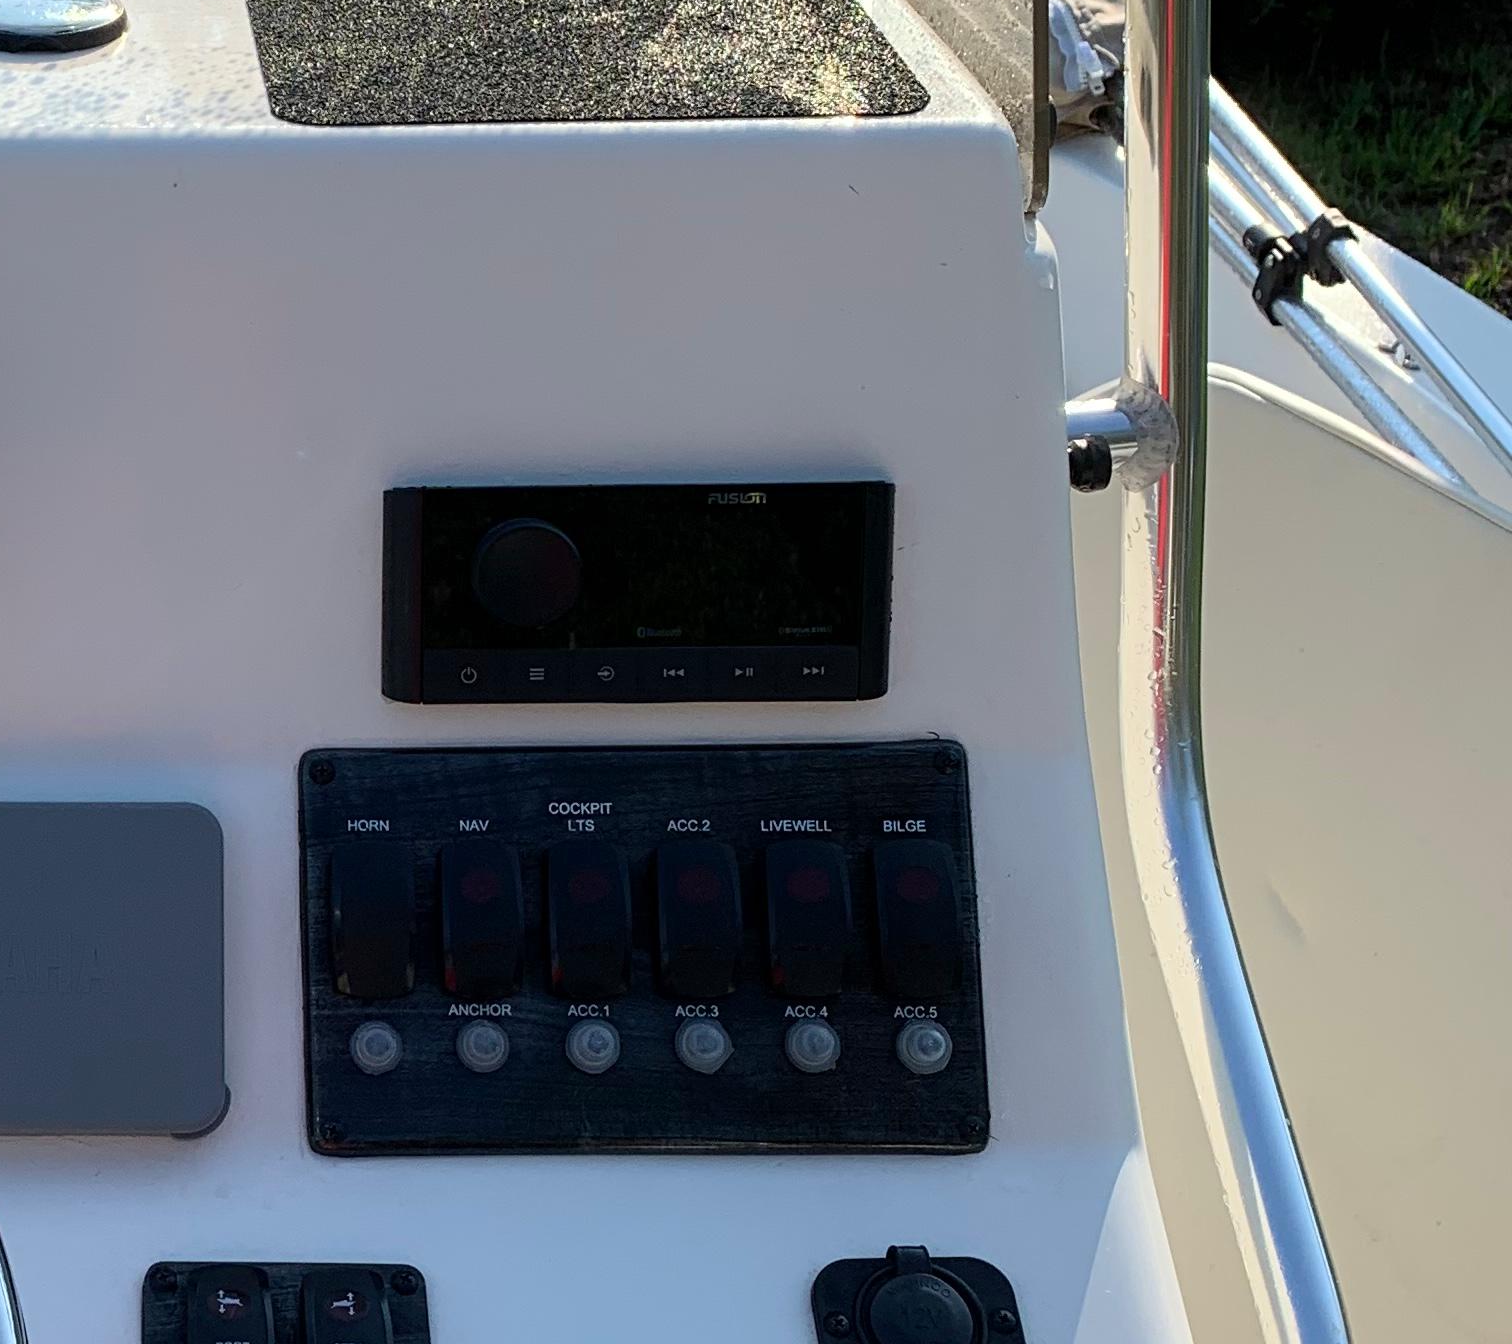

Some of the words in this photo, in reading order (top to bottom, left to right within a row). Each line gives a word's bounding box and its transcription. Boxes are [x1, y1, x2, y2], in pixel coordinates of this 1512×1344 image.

[548, 802, 613, 815] COCKPIT
[347, 819, 390, 832] HORN
[459, 819, 490, 832] NAV
[567, 819, 595, 832] LTS
[667, 818, 711, 832] ACC.2
[760, 819, 832, 832] LIVEWELL
[883, 819, 927, 833] BILGE
[448, 1003, 513, 1017] ANCHOR
[567, 1003, 610, 1017] ACC.1
[674, 1004, 720, 1018] ACC.3
[784, 1005, 829, 1019] ACC.4
[893, 1005, 938, 1019] ACC.5
